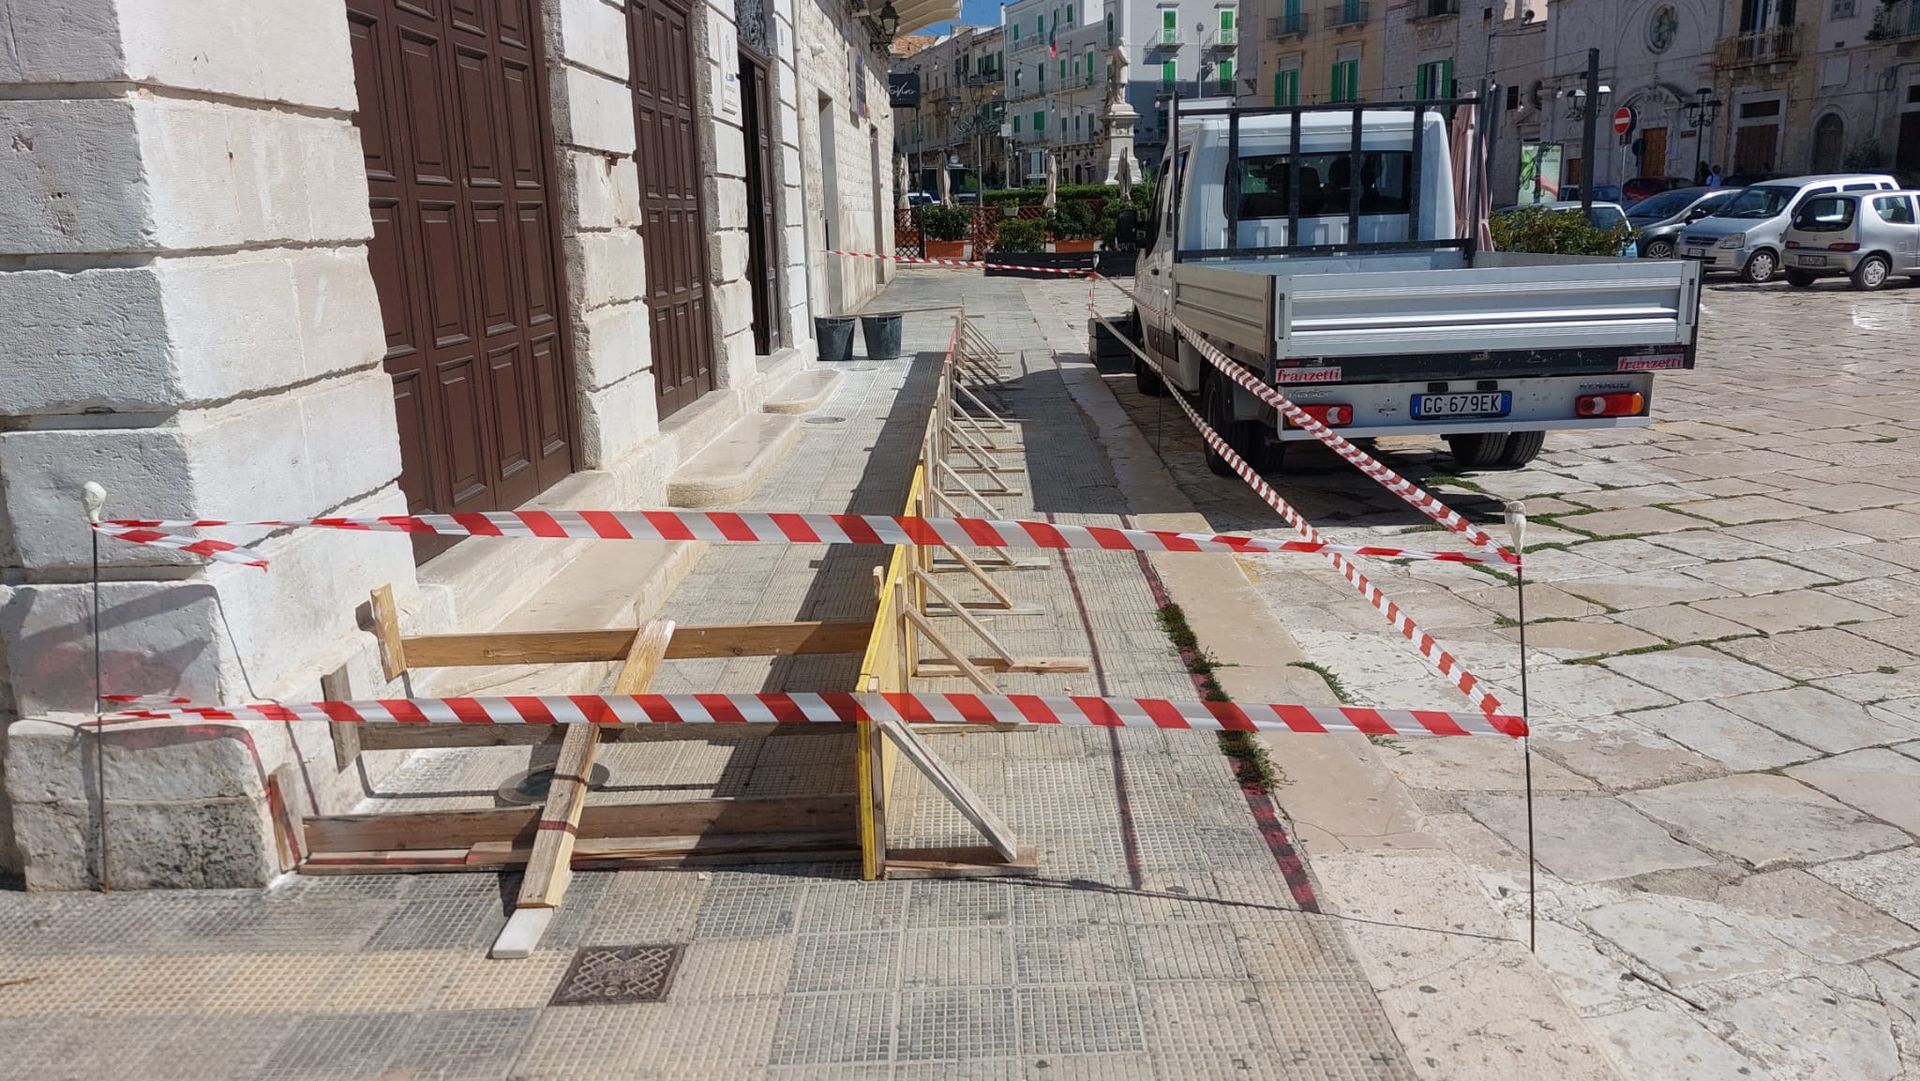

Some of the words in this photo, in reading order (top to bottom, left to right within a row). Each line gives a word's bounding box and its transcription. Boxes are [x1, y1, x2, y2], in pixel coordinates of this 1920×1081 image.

[1619, 356, 1682, 370] franzetti
[1277, 368, 1340, 381] franzetti
[1424, 397, 1442, 413] GG
[1449, 395, 1499, 412] 679EK
